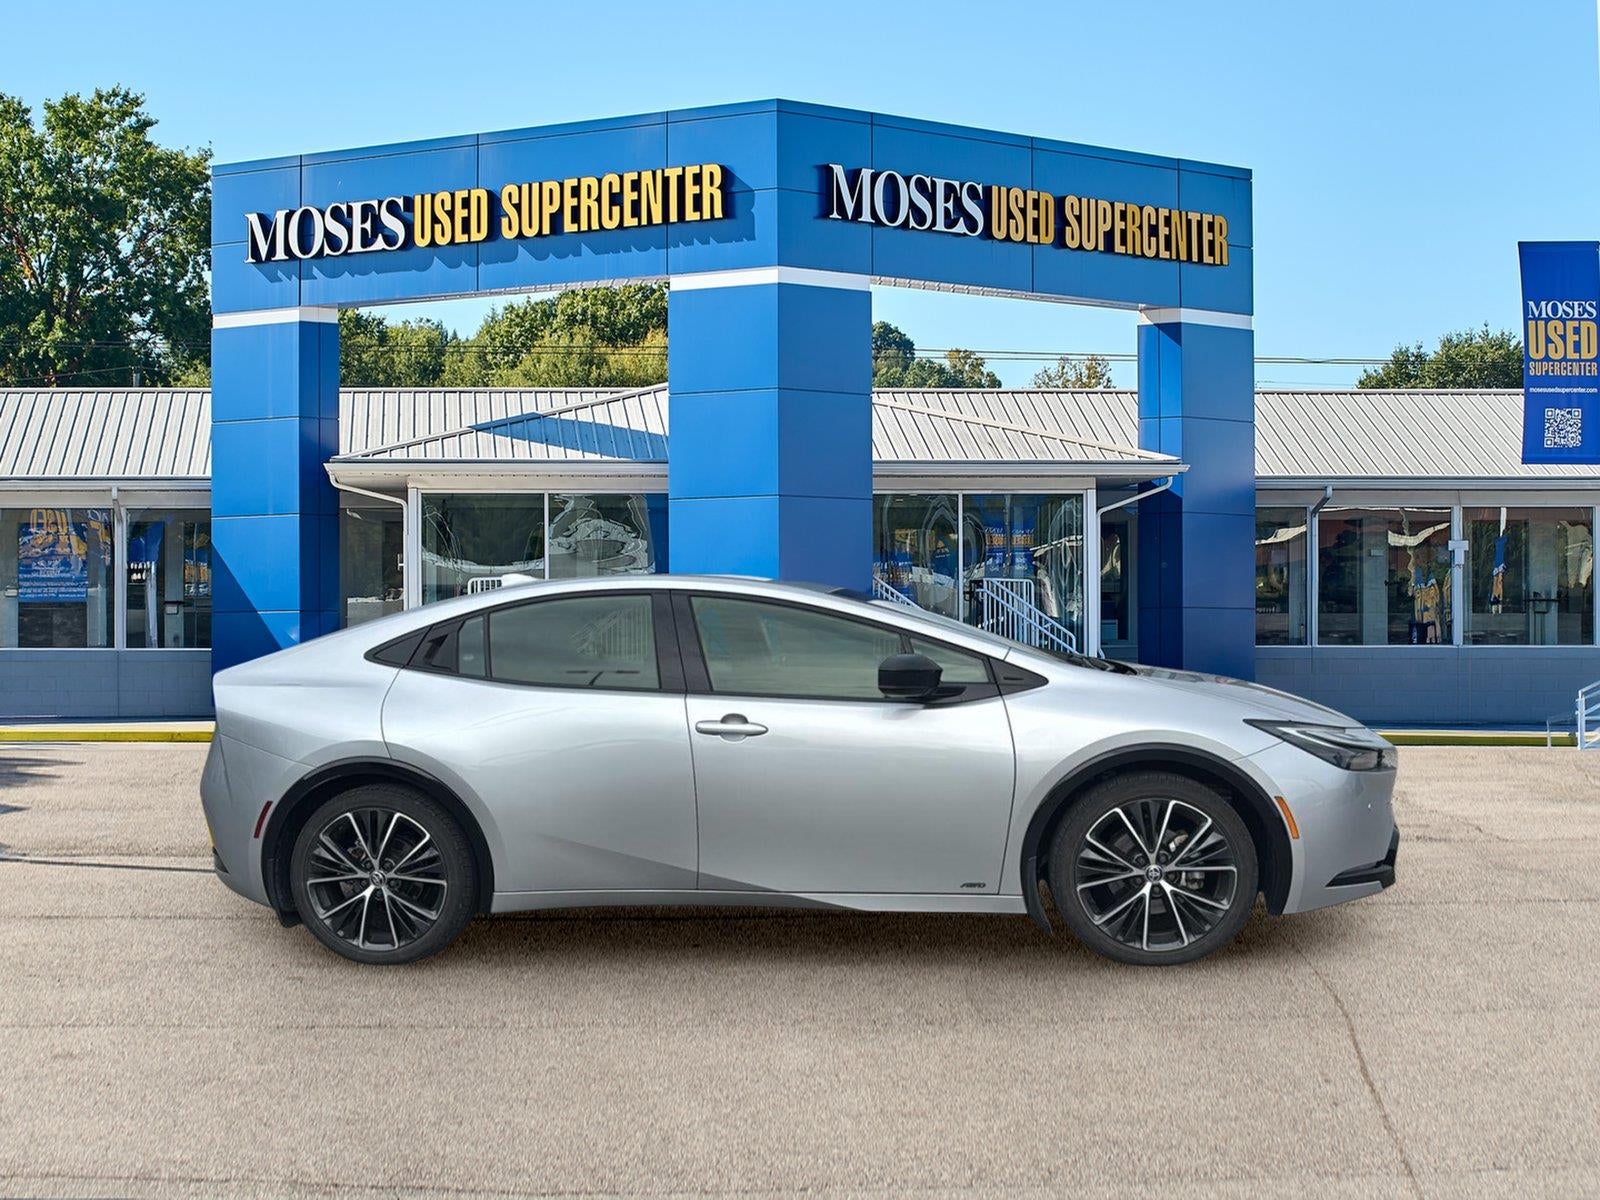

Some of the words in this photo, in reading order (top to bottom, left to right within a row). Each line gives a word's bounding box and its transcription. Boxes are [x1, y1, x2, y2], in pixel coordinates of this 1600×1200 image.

[244, 196, 407, 264] MOSES
[413, 188, 488, 247] USED
[500, 164, 723, 239] SUPERCENTER
[829, 164, 984, 236] MOSES
[991, 185, 1055, 245] USED
[1065, 194, 1229, 265] SUPERCENTER
[1528, 301, 1597, 318] MOSES
[1528, 320, 1598, 360] USED
[1529, 361, 1598, 376] SUPERCENTER
